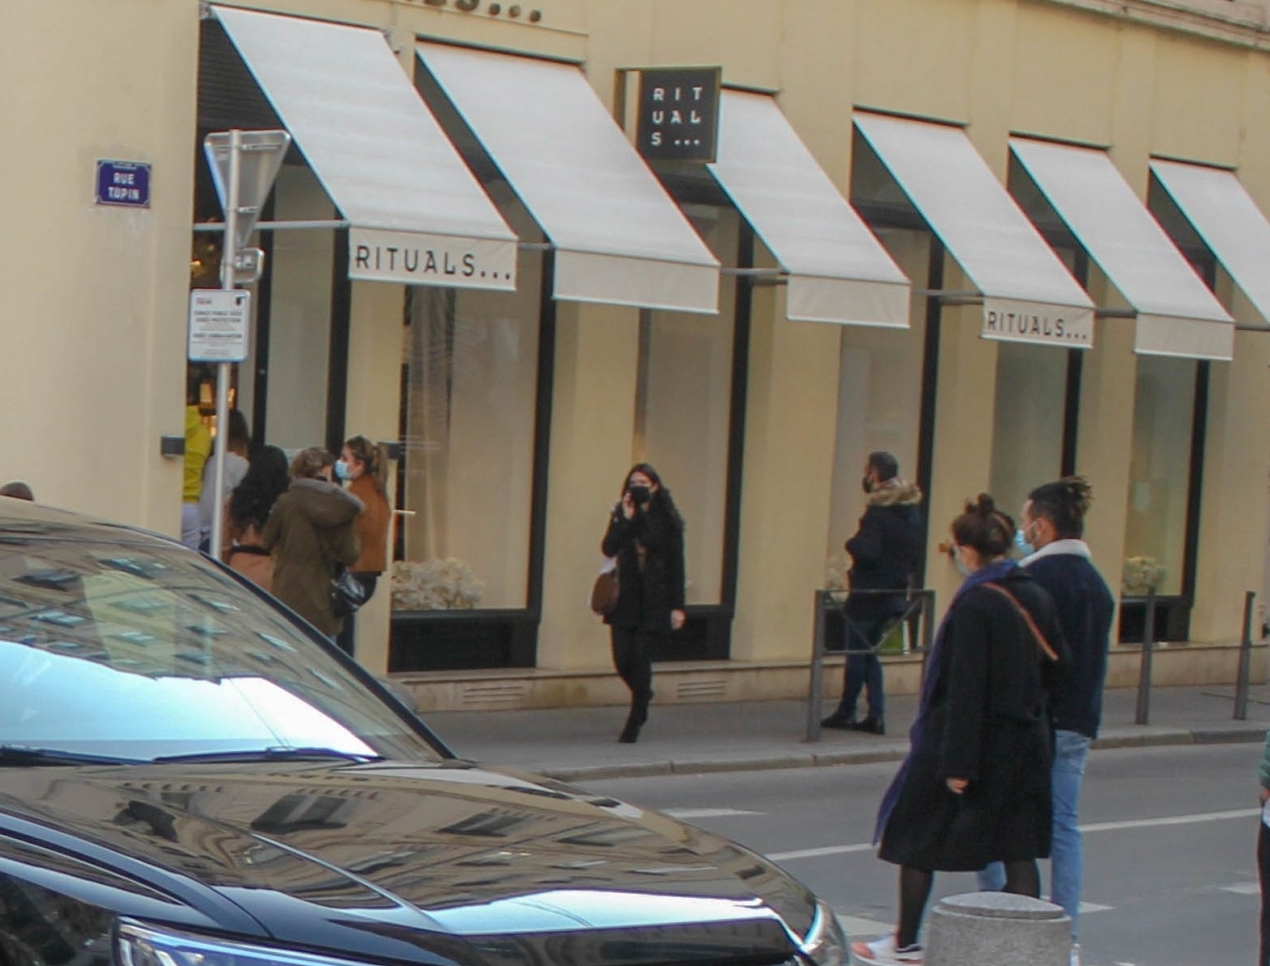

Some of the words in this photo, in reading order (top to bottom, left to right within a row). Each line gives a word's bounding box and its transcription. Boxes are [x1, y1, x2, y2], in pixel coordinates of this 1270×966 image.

[113, 172, 134, 185] RUE
[108, 187, 139, 200] TUPIN
[355, 245, 511, 280] RITUALS...
[988, 311, 1087, 339] RITUALS...
